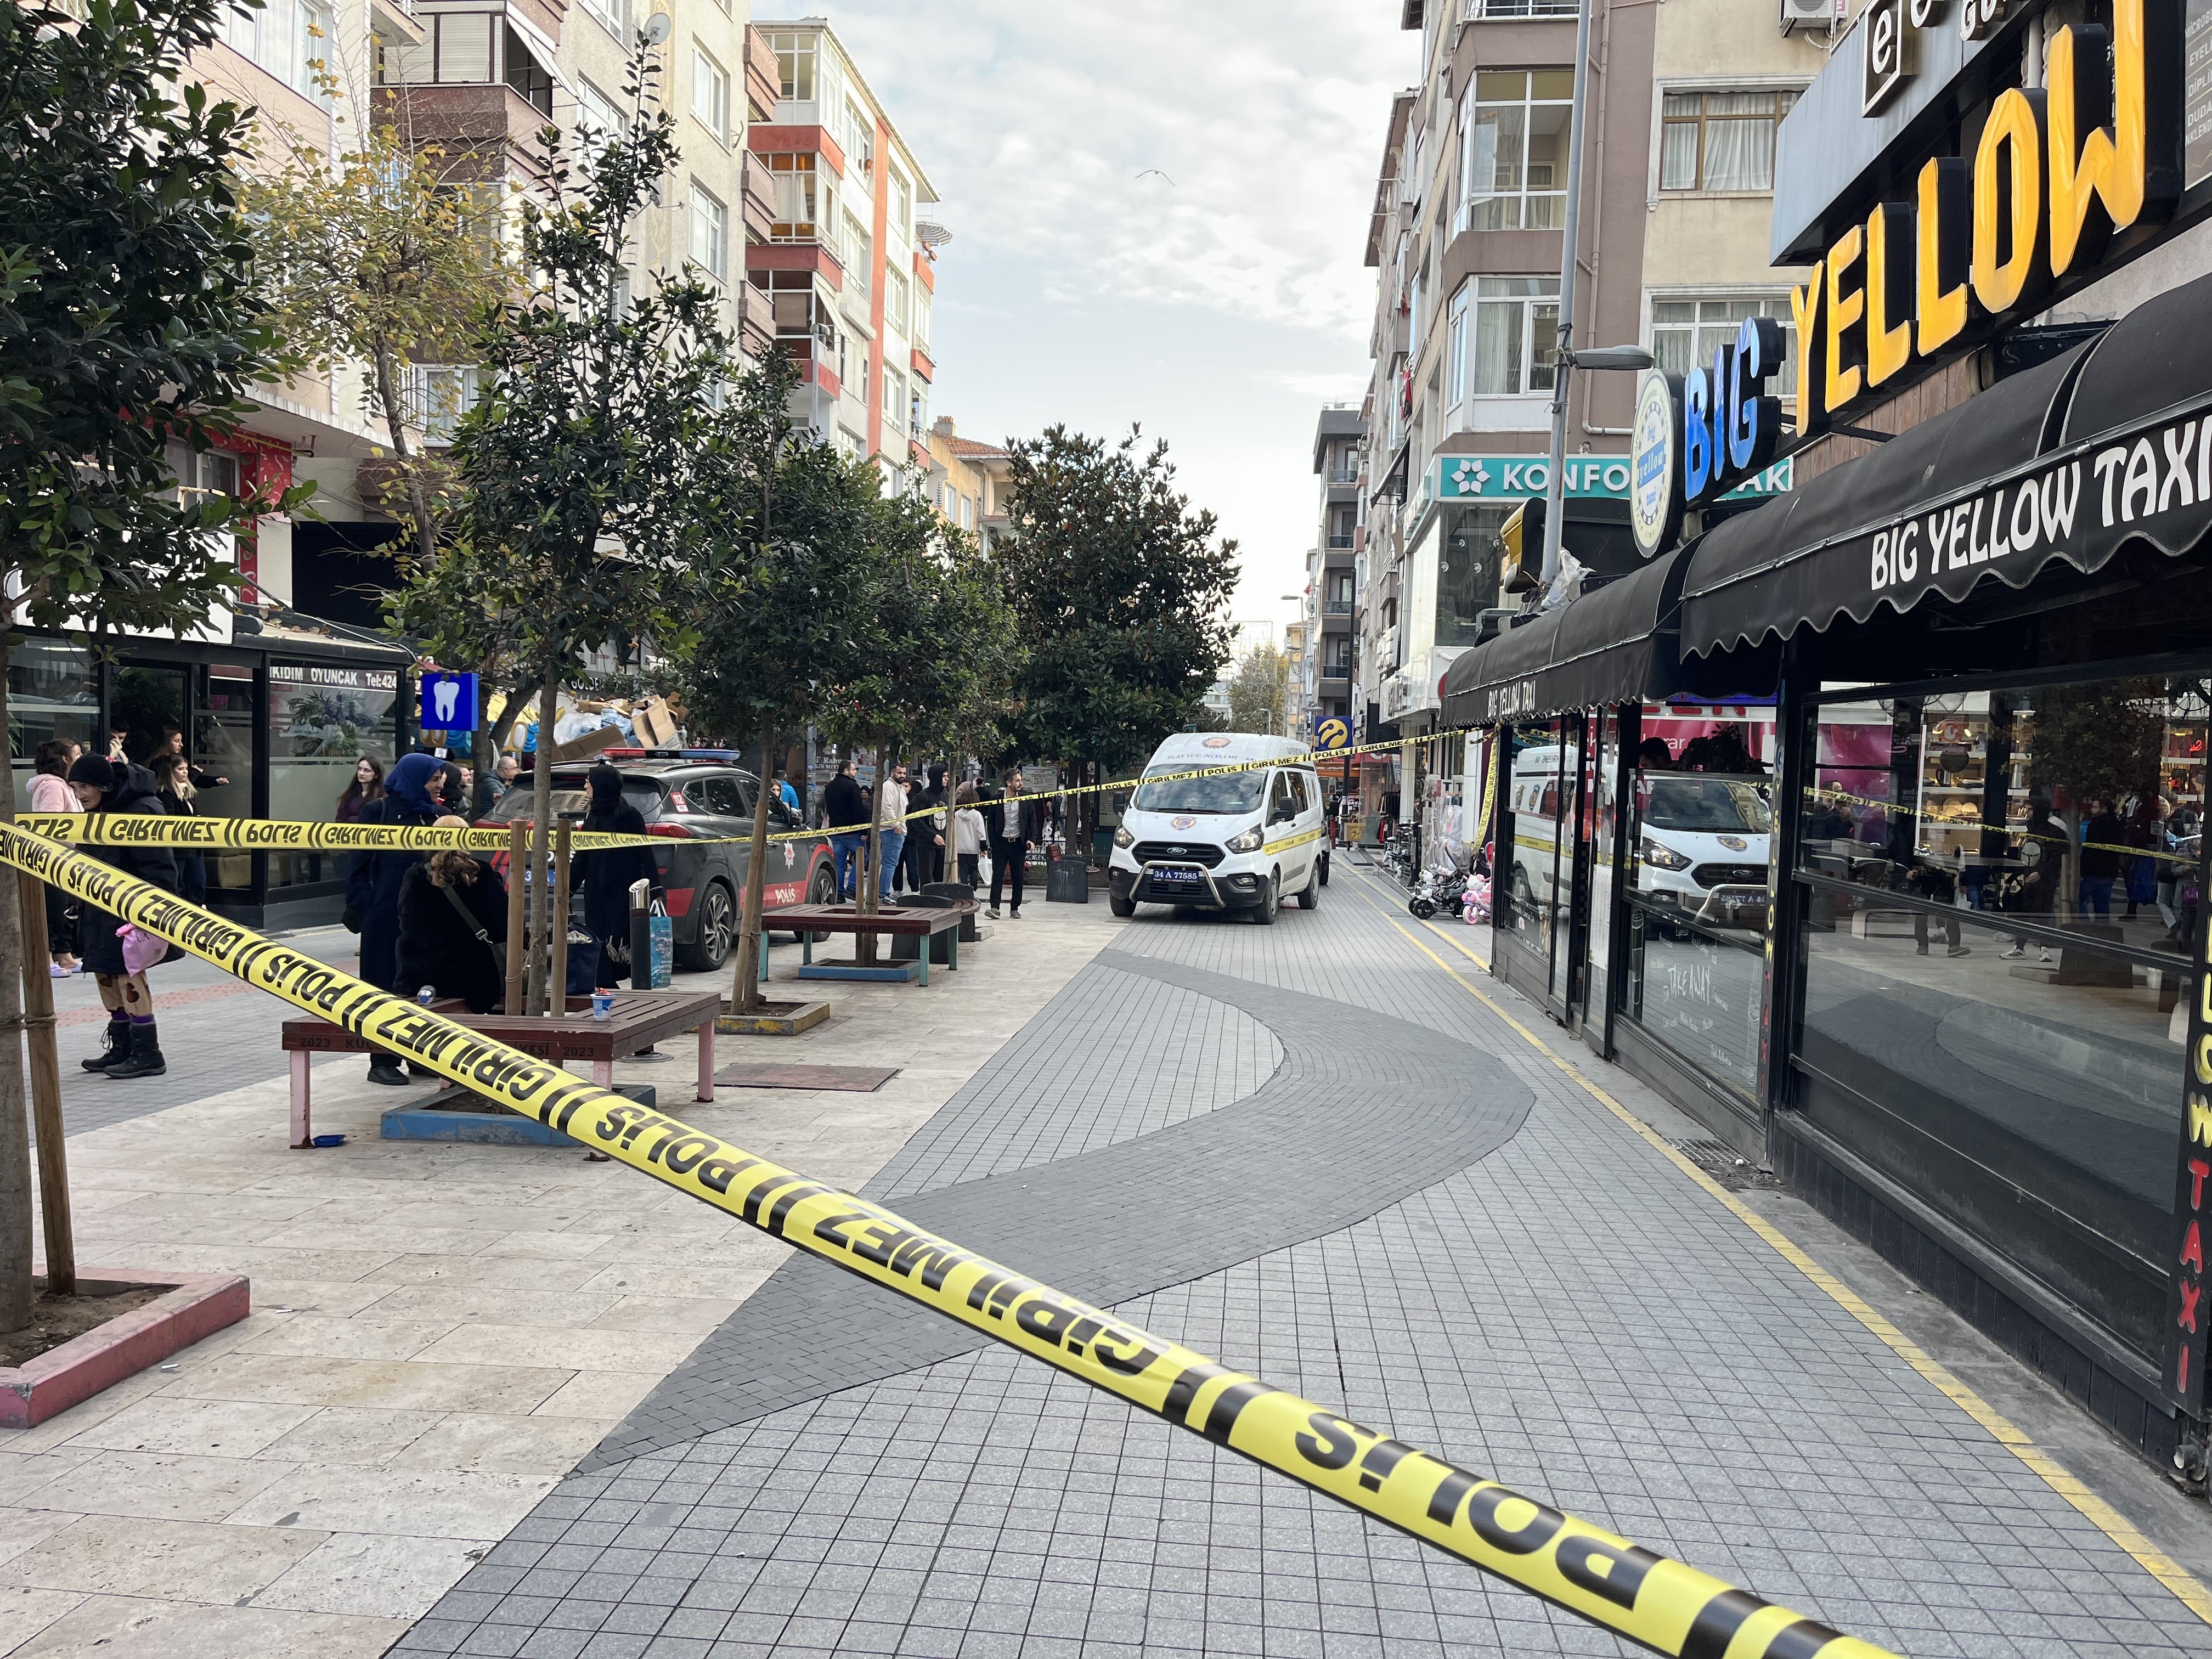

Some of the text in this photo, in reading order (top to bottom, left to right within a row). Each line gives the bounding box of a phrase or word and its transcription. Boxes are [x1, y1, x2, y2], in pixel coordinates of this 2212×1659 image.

[1685, 0, 2145, 501] BIG YELLOW
[1647, 424, 1656, 443] big
[1503, 464, 1789, 492] KONFO AK
[1639, 451, 1664, 483] yellow
[1871, 415, 2212, 590] BIG YELLOW TAXI
[311, 668, 358, 686] OYUNCAK
[1488, 680, 1536, 718] BIG YELLOW TAXI
[1251, 756, 1300, 769] GİRİLMEZ
[673, 794, 684, 805] 112
[0, 827, 53, 875] GİRİLME
[68, 861, 125, 907] POLİS
[775, 883, 795, 904] POLİS
[137, 893, 245, 961] GİRİLMEZ
[262, 953, 359, 1013] POLİS
[1668, 963, 1711, 1006] TAKE AWAY
[377, 1005, 557, 1101] GİRİLMEZ
[563, 1046, 595, 1058] 2023
[596, 1105, 760, 1194] POLİS
[1295, 1412, 1664, 1611] POLİS
